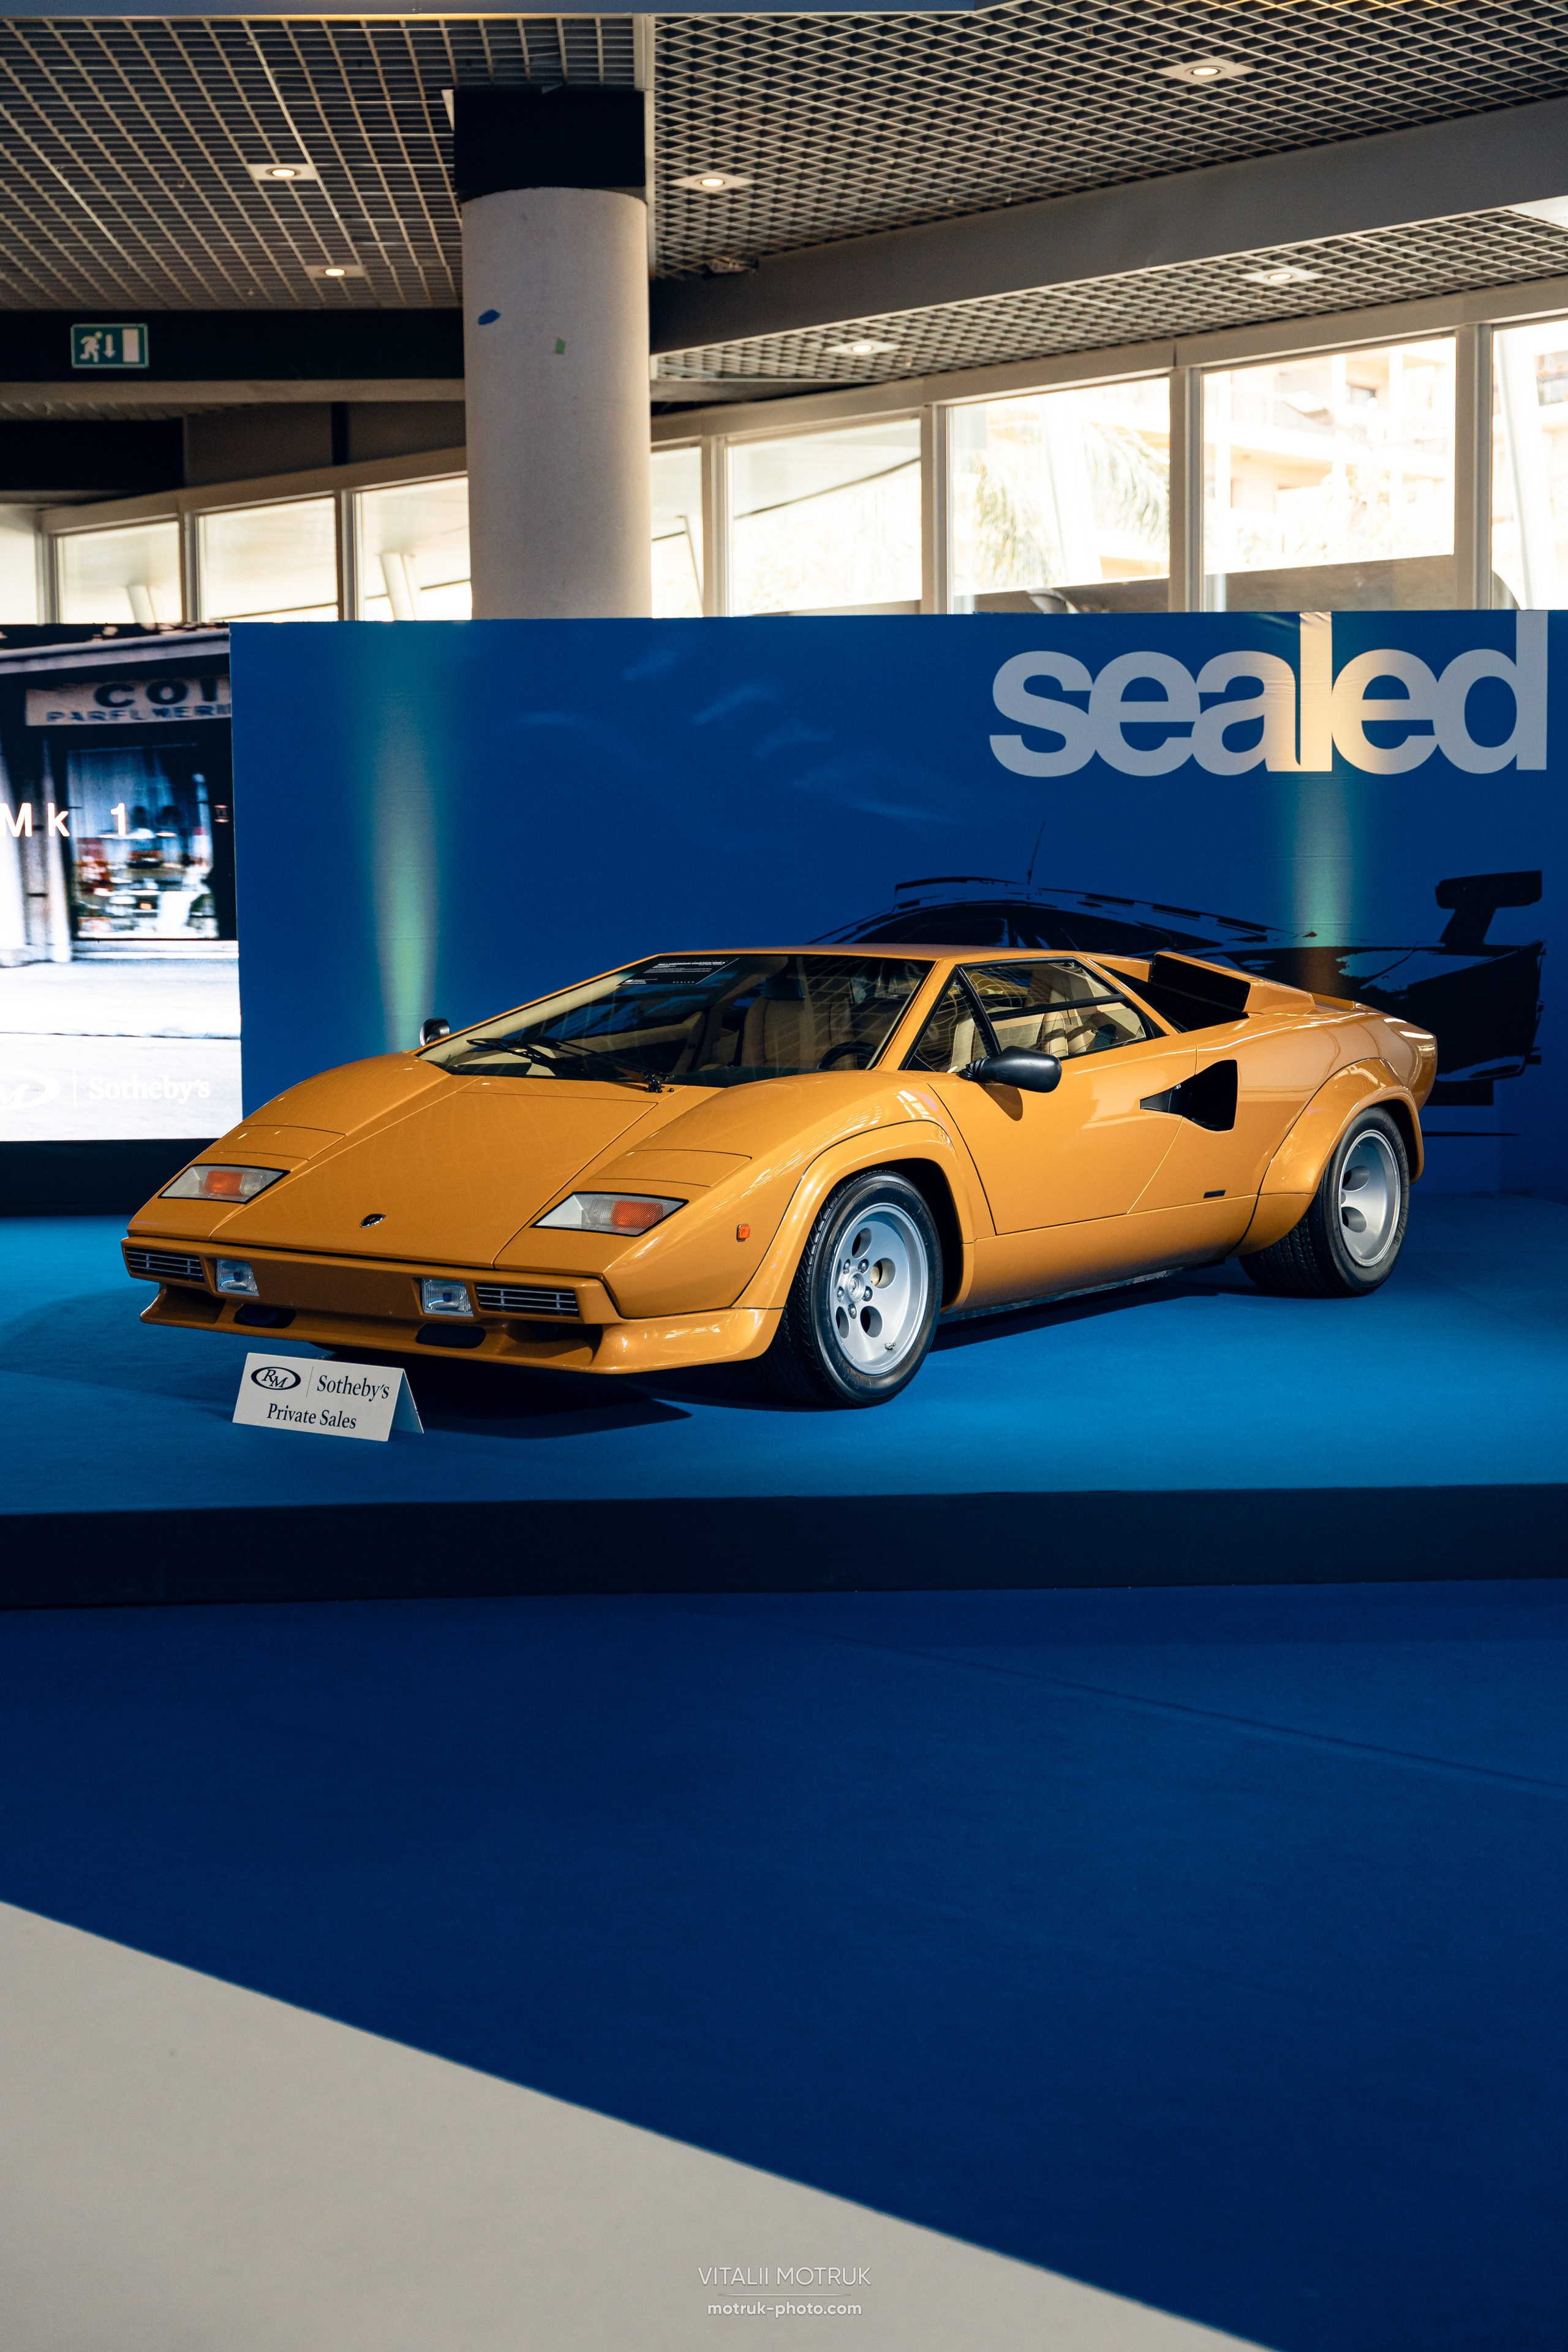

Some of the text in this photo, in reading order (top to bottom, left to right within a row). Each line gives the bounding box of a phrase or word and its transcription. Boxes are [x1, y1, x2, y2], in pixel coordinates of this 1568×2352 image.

[989, 610, 1548, 777] sealed
[0, 802, 126, 838] Mk 1
[88, 1074, 211, 1105] Sotheby's
[261, 1369, 390, 1402] RM Sotheby's
[266, 1403, 357, 1429] Private Sales
